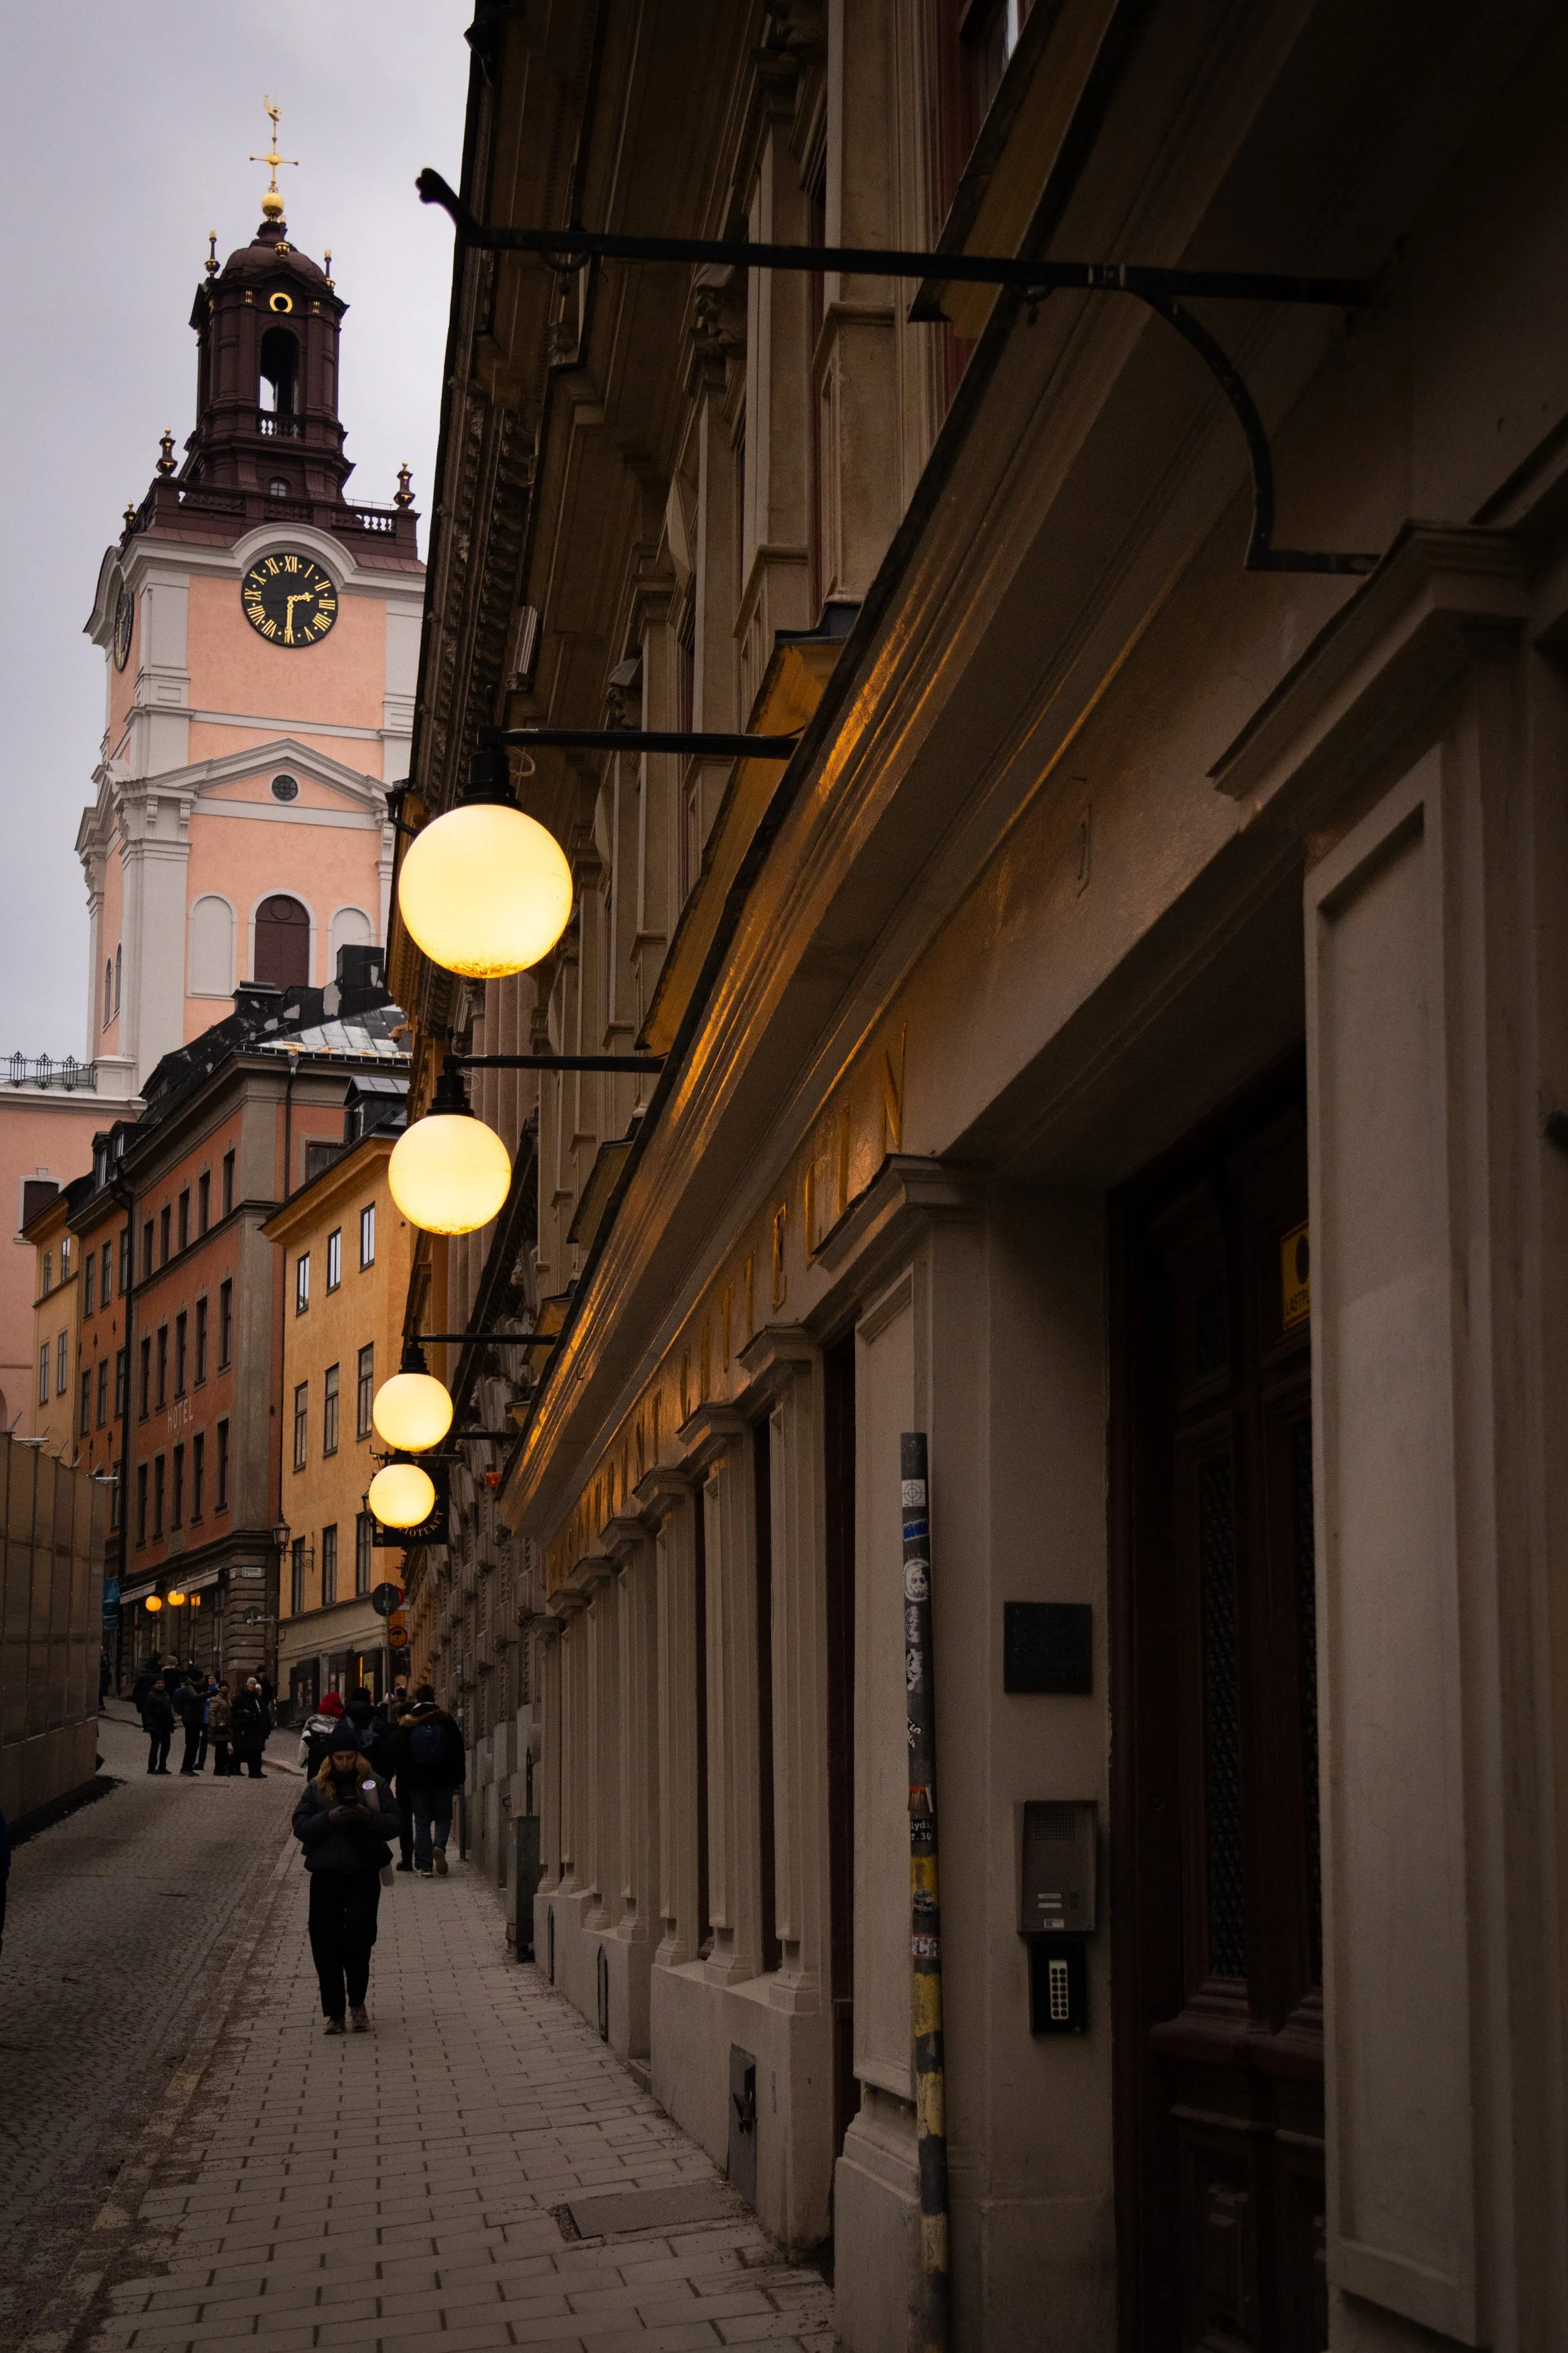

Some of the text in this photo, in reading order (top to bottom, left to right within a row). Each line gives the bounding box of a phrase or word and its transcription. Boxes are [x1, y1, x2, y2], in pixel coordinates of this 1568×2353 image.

[264, 557, 280, 576] XI
[284, 555, 298, 573] XII
[250, 570, 267, 586] X
[314, 580, 331, 592] II
[319, 599, 336, 610] III
[167, 1396, 193, 1433] HOTEL
